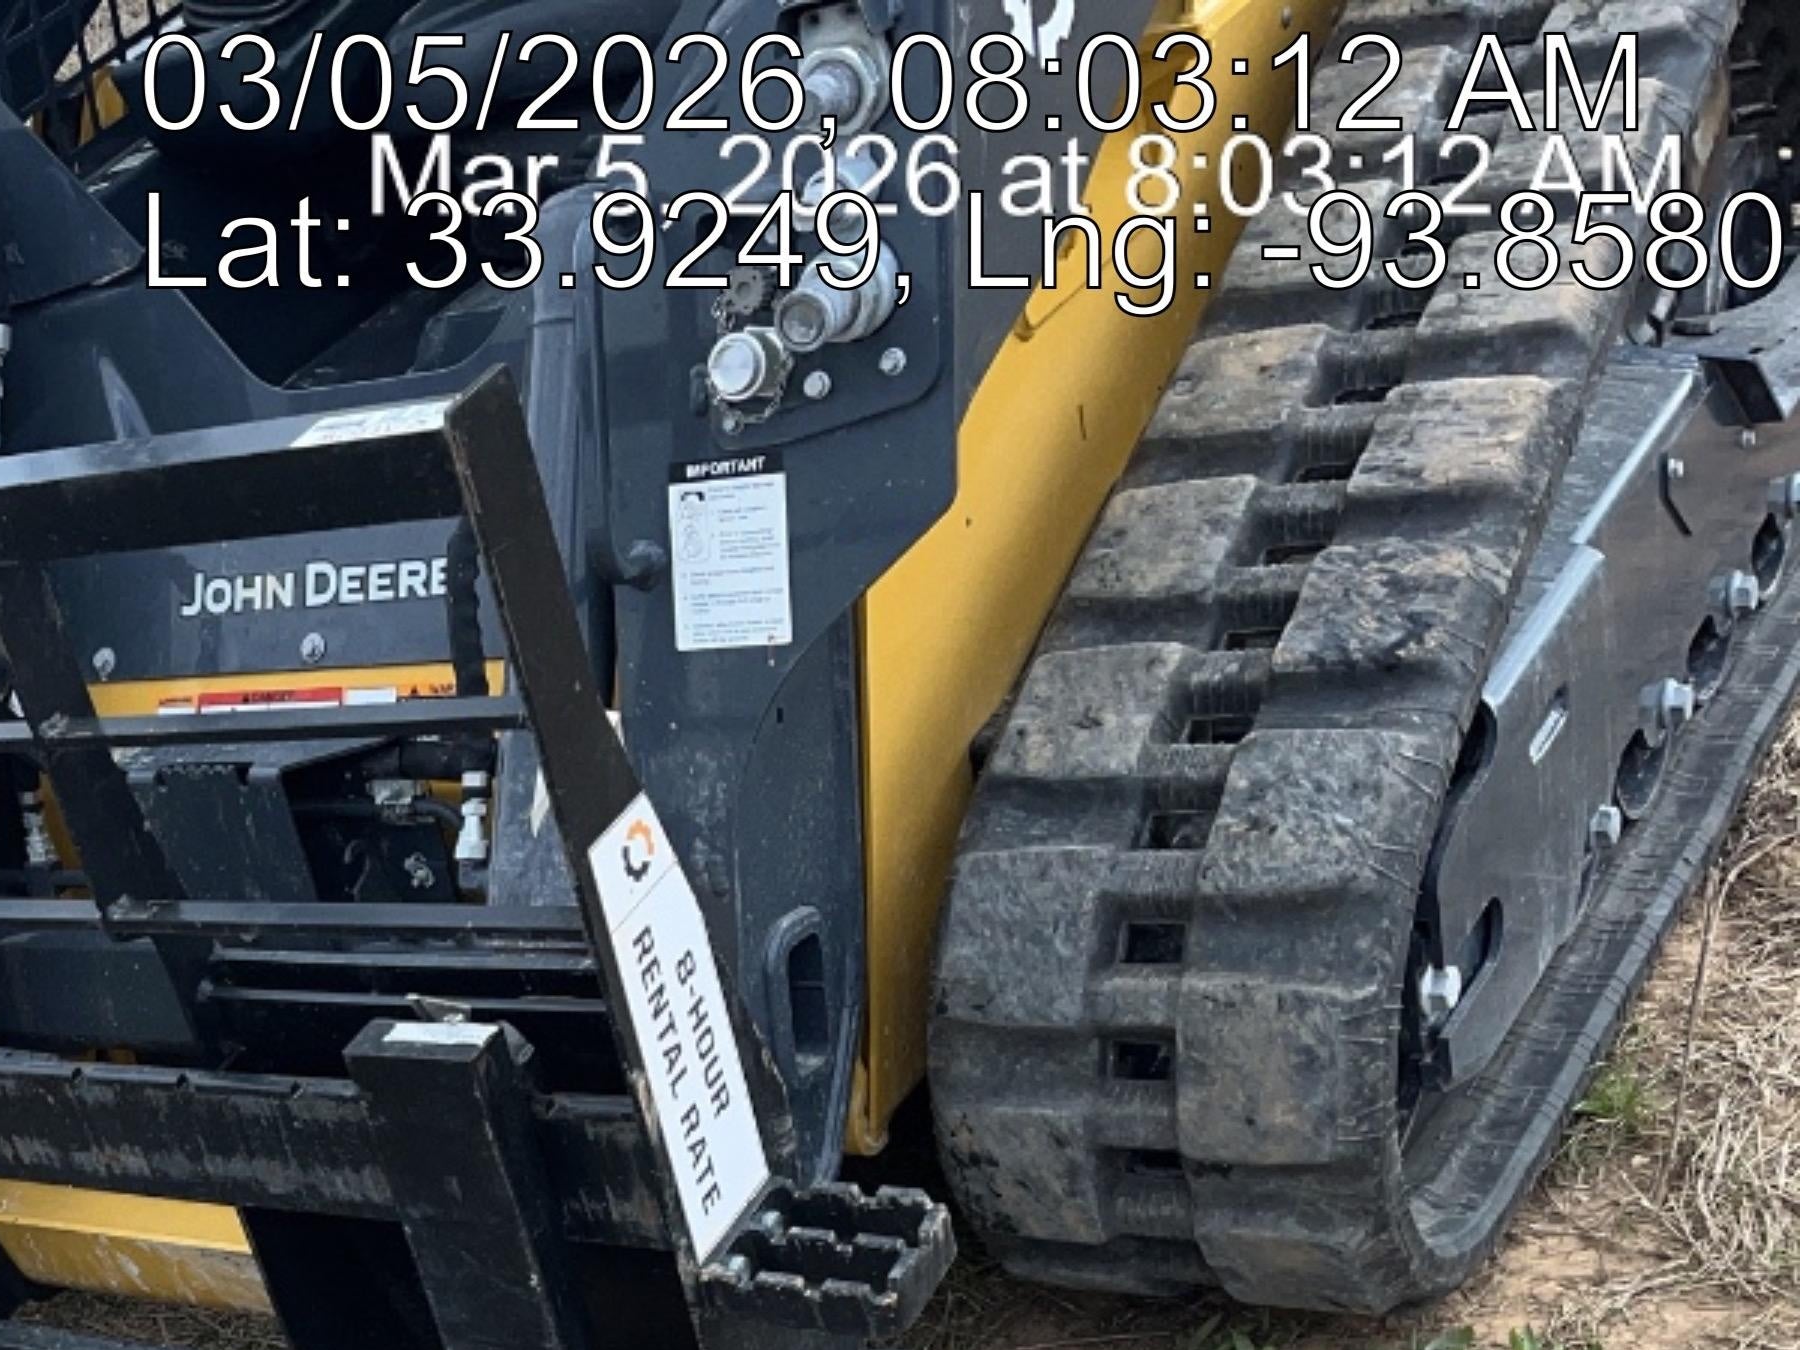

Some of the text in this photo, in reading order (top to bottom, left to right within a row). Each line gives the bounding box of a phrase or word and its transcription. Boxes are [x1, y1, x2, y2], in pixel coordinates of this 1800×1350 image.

[686, 455, 767, 478] IMPORTANT
[179, 556, 449, 617] JOHN DEERE
[632, 925, 723, 1215] RENTAL RATE
[675, 948, 731, 1118] 8-HOUR
